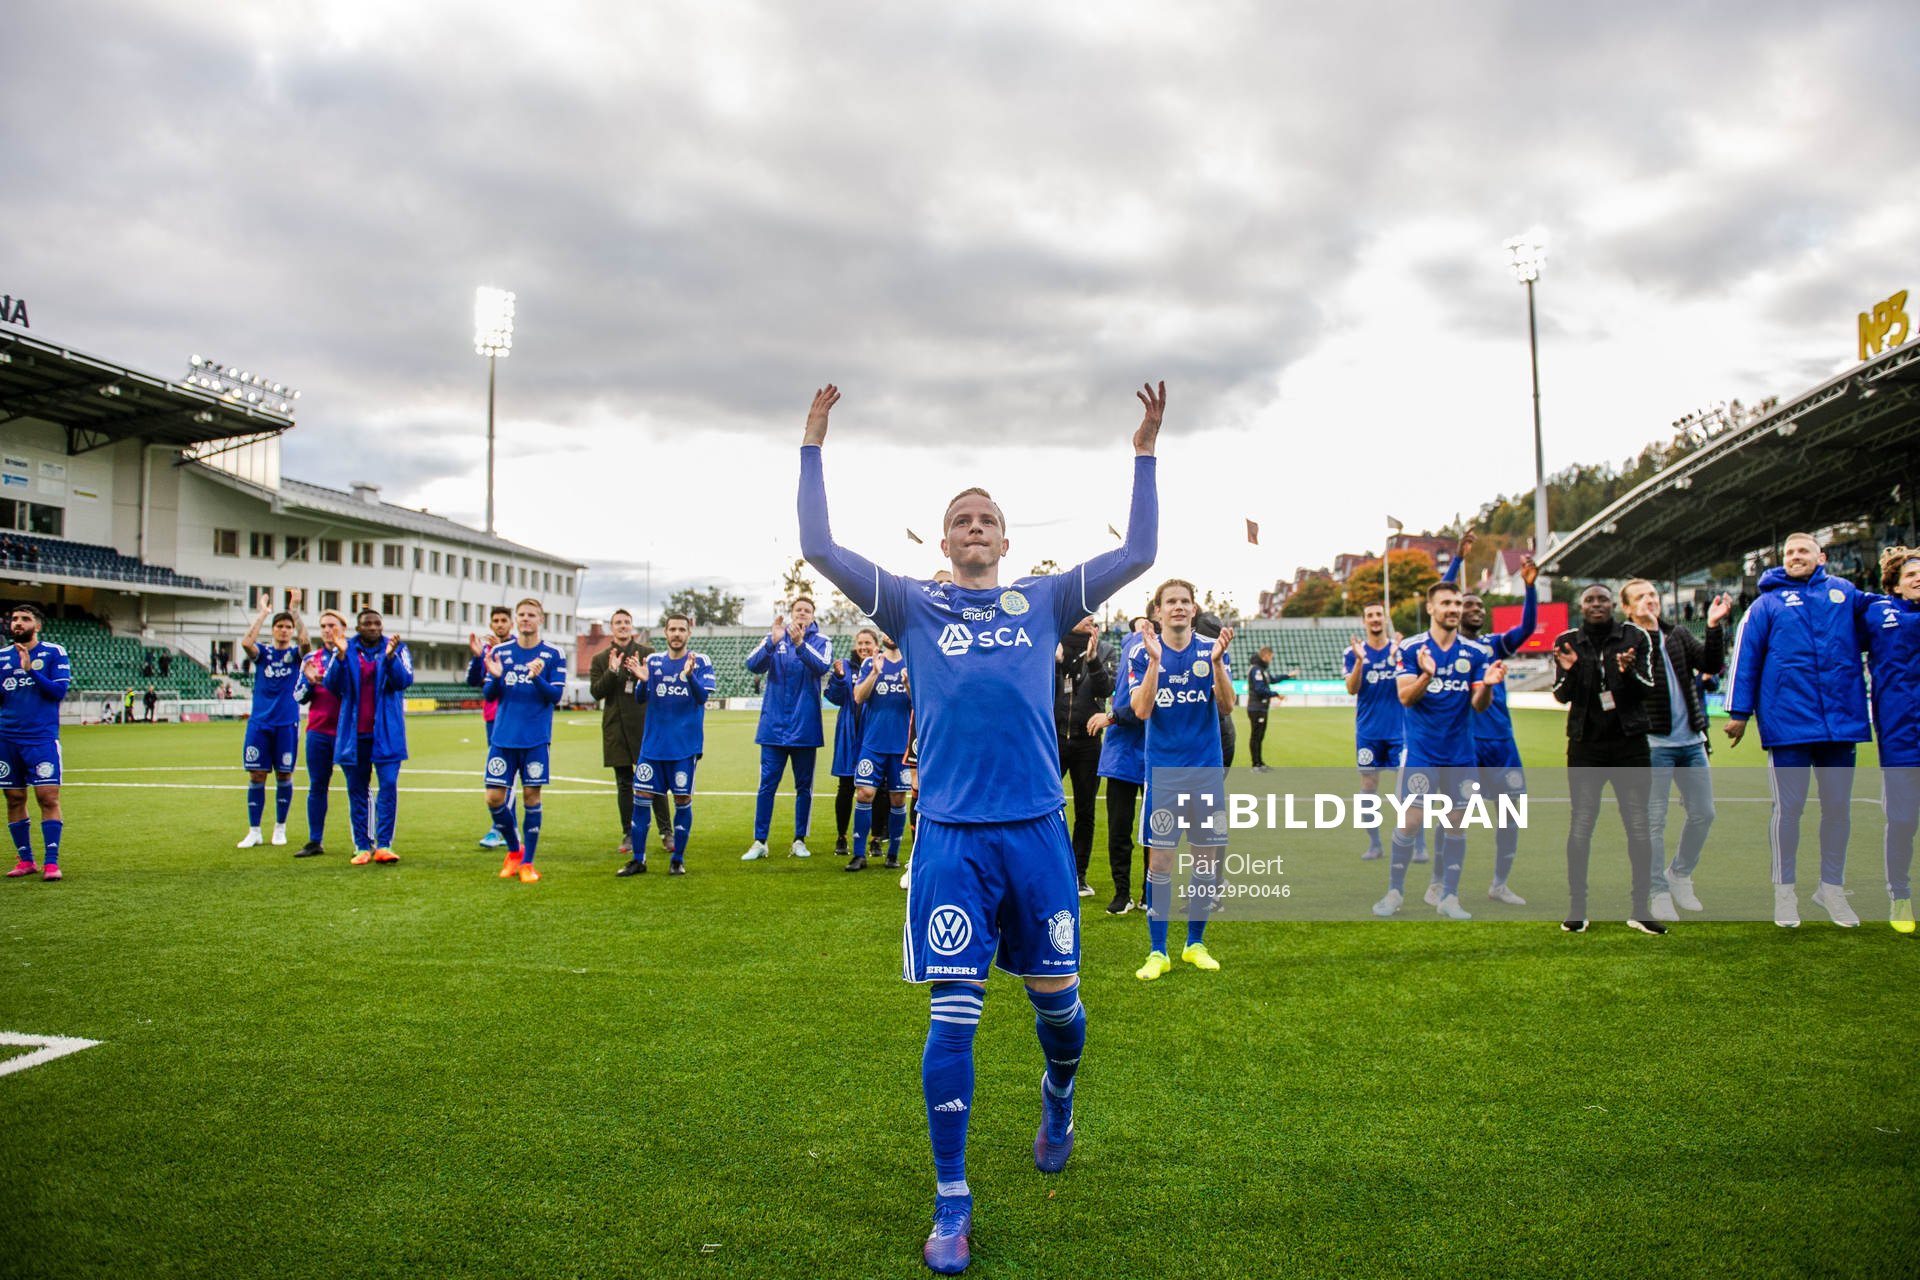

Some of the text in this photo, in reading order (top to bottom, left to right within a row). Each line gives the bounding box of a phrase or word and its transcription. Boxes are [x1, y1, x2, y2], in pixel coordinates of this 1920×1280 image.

[962, 607, 996, 622] energi
[977, 627, 1033, 648] SCA
[18, 677, 35, 687] SC
[518, 674, 534, 684] SC
[1443, 680, 1470, 691] SCA
[667, 686, 689, 697] SCA
[1176, 690, 1208, 703] SCA
[926, 965, 978, 975] ERNERS
